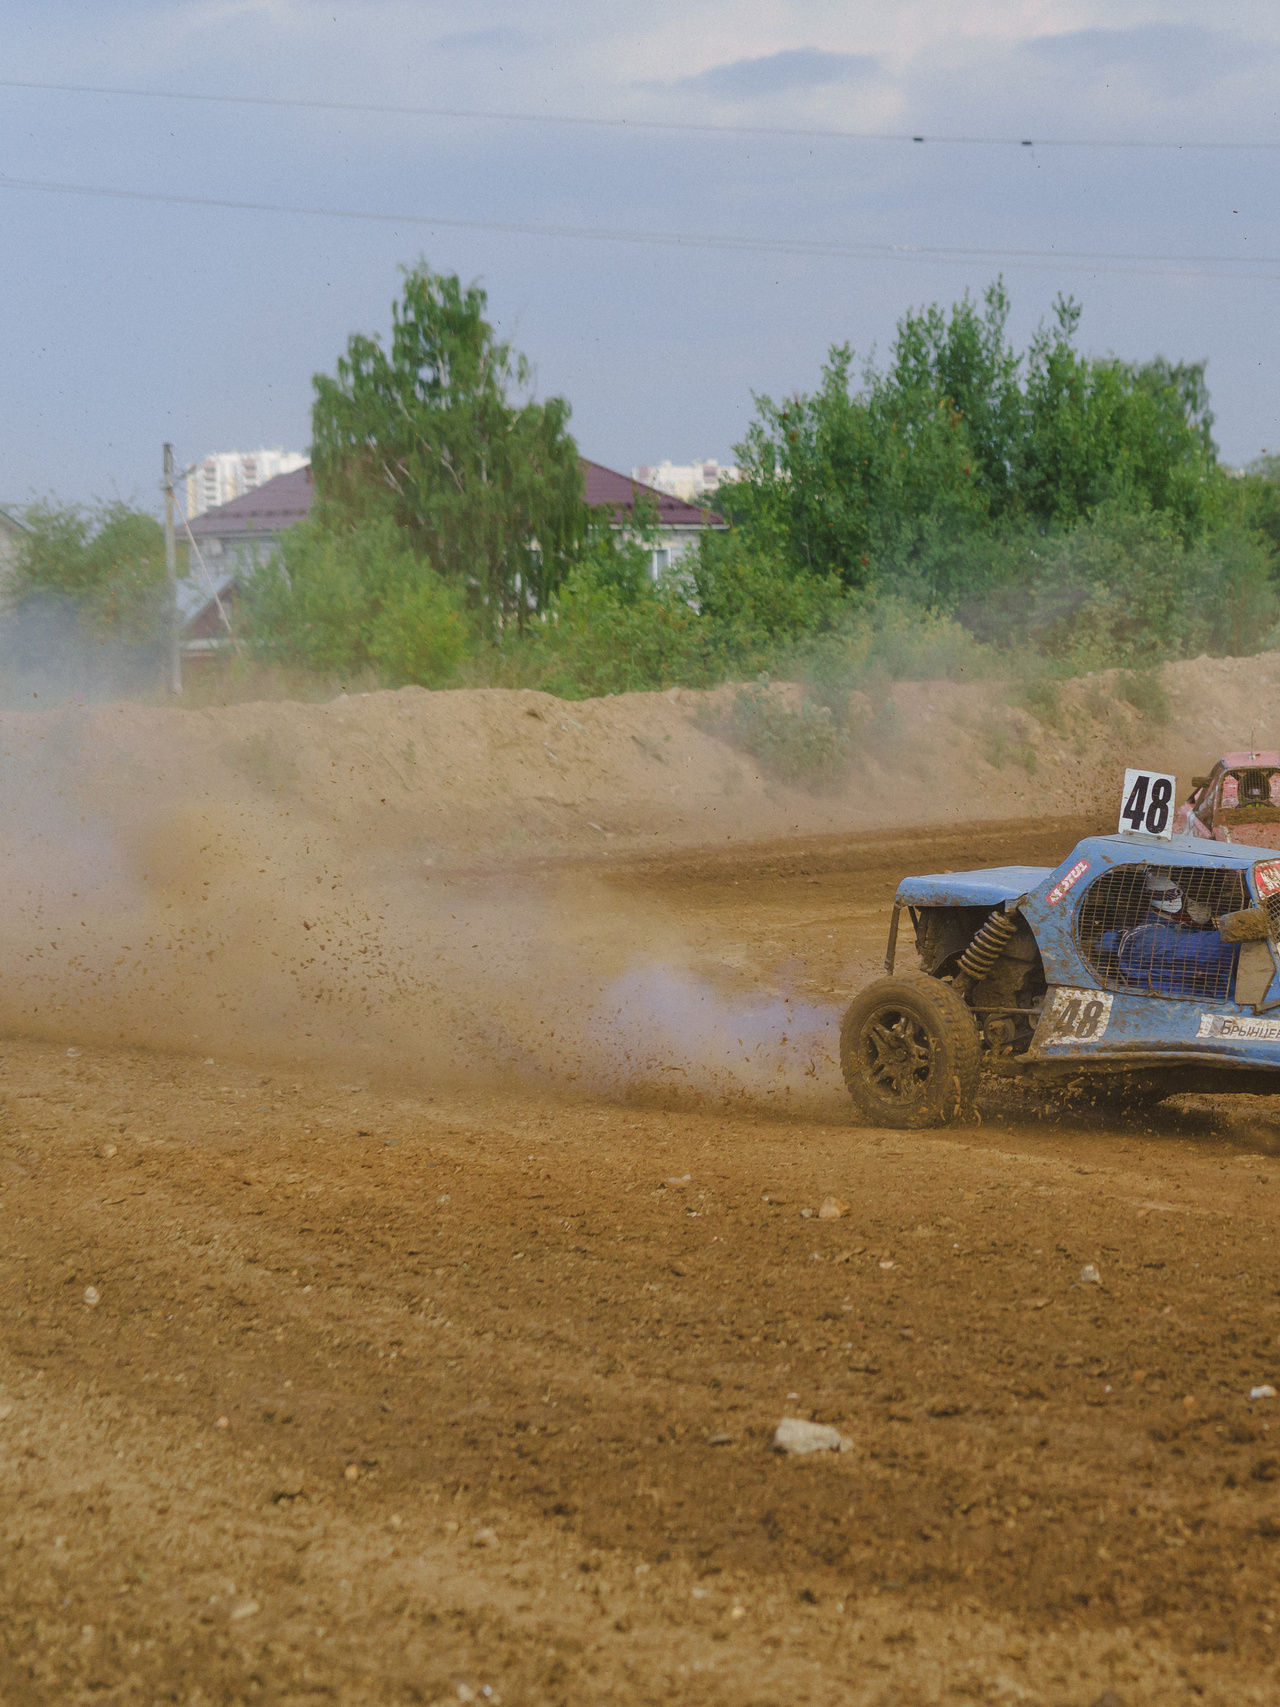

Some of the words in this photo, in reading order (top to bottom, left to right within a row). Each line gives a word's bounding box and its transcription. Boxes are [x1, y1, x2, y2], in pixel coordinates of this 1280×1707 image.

[1122, 775, 1172, 834] 48
[1050, 862, 1088, 903] MOTUL
[1057, 999, 1104, 1038] 48
